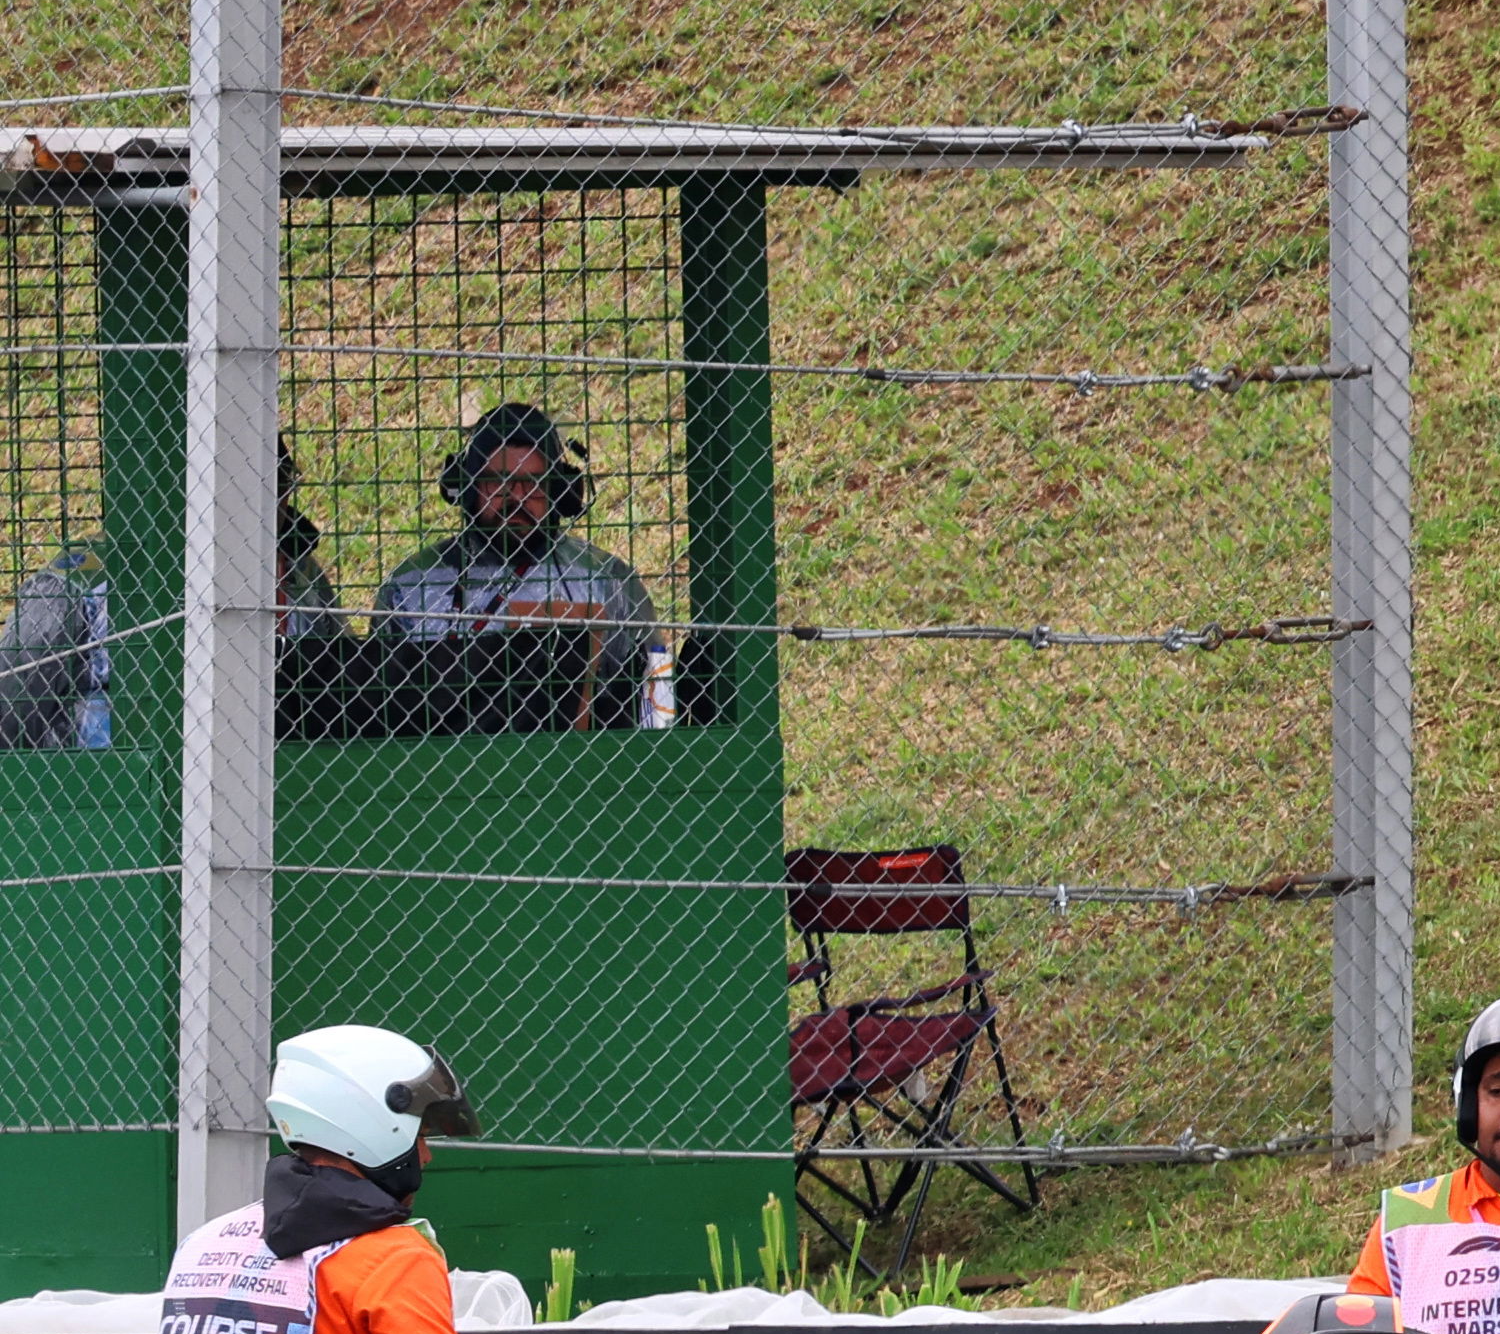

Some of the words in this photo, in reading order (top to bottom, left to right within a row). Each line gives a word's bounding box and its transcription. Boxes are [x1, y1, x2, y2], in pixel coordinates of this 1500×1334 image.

[198, 1251, 243, 1268] DEPUTY
[241, 1254, 278, 1271] CHIEF
[171, 1272, 231, 1288] RECOVERY
[228, 1273, 288, 1296] MARSHAL
